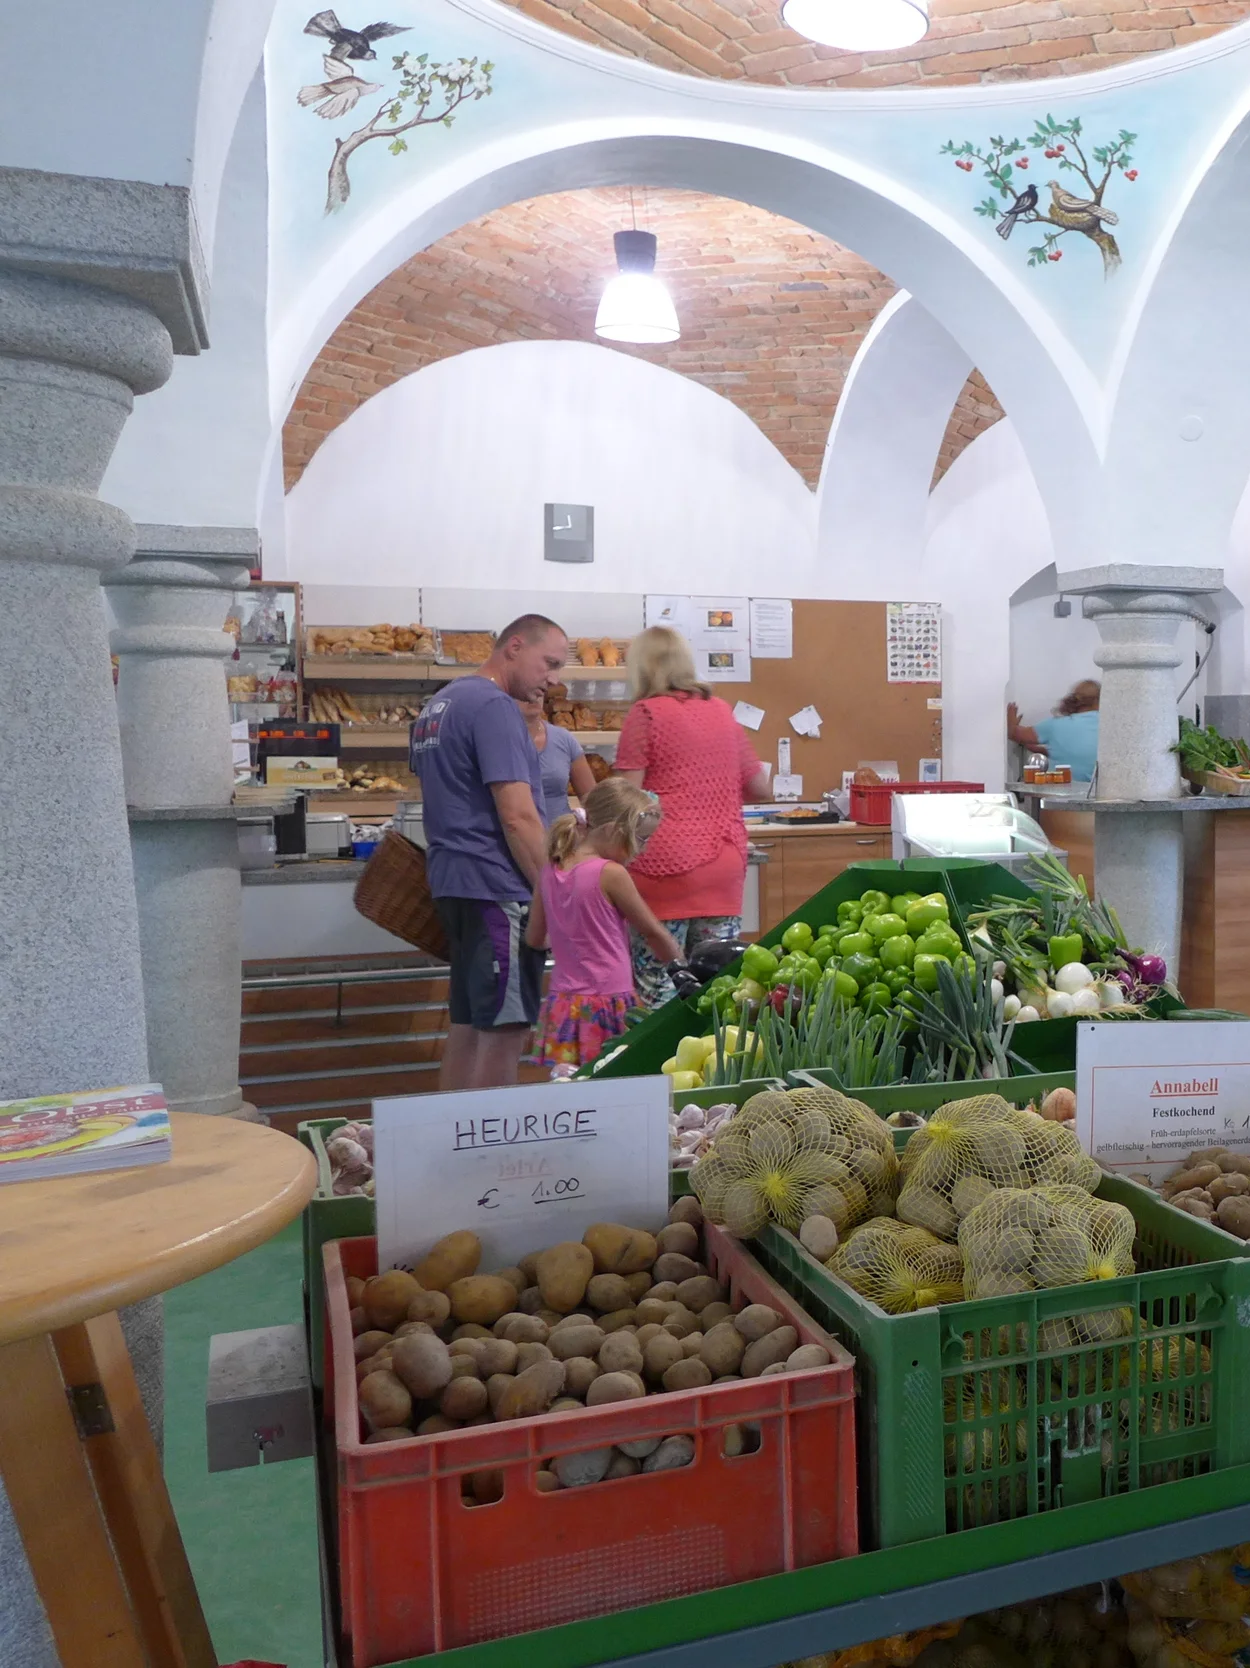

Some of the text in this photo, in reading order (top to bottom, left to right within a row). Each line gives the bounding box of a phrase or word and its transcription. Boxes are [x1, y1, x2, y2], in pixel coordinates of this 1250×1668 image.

[1150, 1078, 1218, 1094] Annabell
[1153, 1106, 1215, 1117] Festkochend
[455, 1109, 597, 1148] HEURIGE
[1151, 1127, 1216, 1139] Früh-erdapfelsorte
[1096, 1141, 1144, 1154] gelbfleischig
[1151, 1139, 1206, 1150] hervorragender
[477, 1177, 580, 1210] € 1.00
